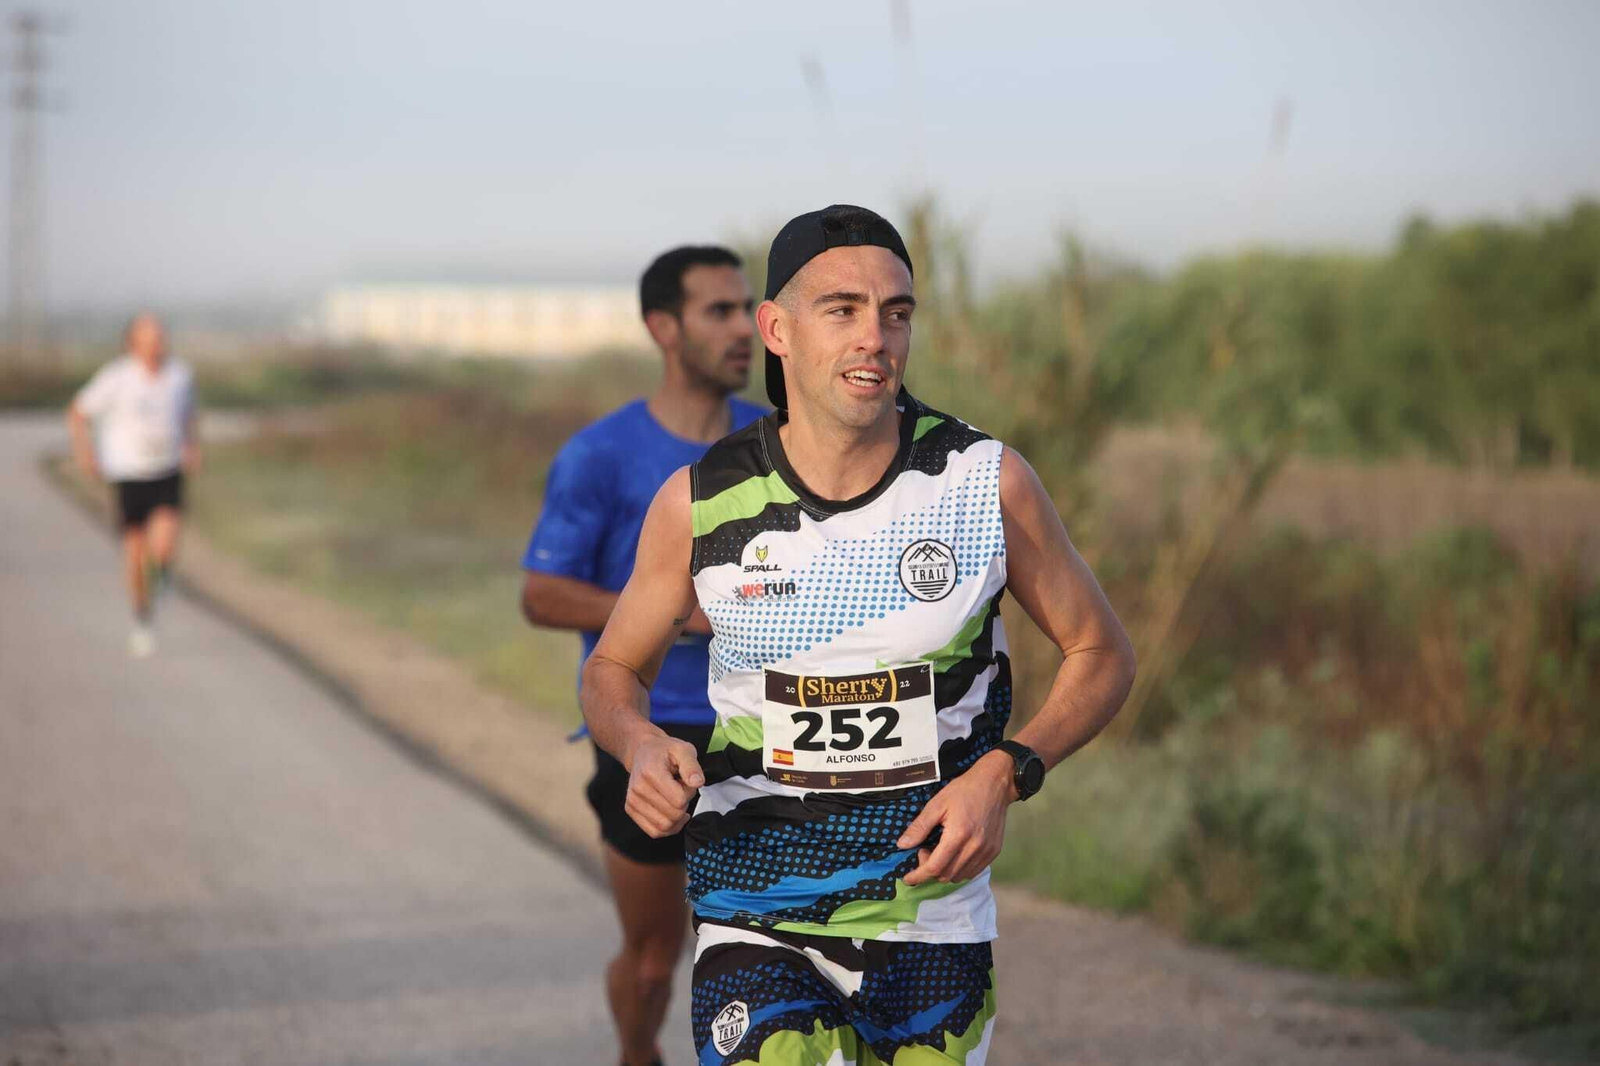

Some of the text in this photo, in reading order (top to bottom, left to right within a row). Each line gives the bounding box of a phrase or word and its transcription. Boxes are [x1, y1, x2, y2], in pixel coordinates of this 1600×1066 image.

[743, 564, 782, 573] SPALL
[911, 568, 947, 581] TRAIL
[742, 582, 796, 597] werun
[785, 677, 911, 698] 20 Sherry 22
[790, 706, 902, 751] 252
[826, 753, 876, 764] ALFONSO
[718, 1022, 743, 1041] TRAIL
